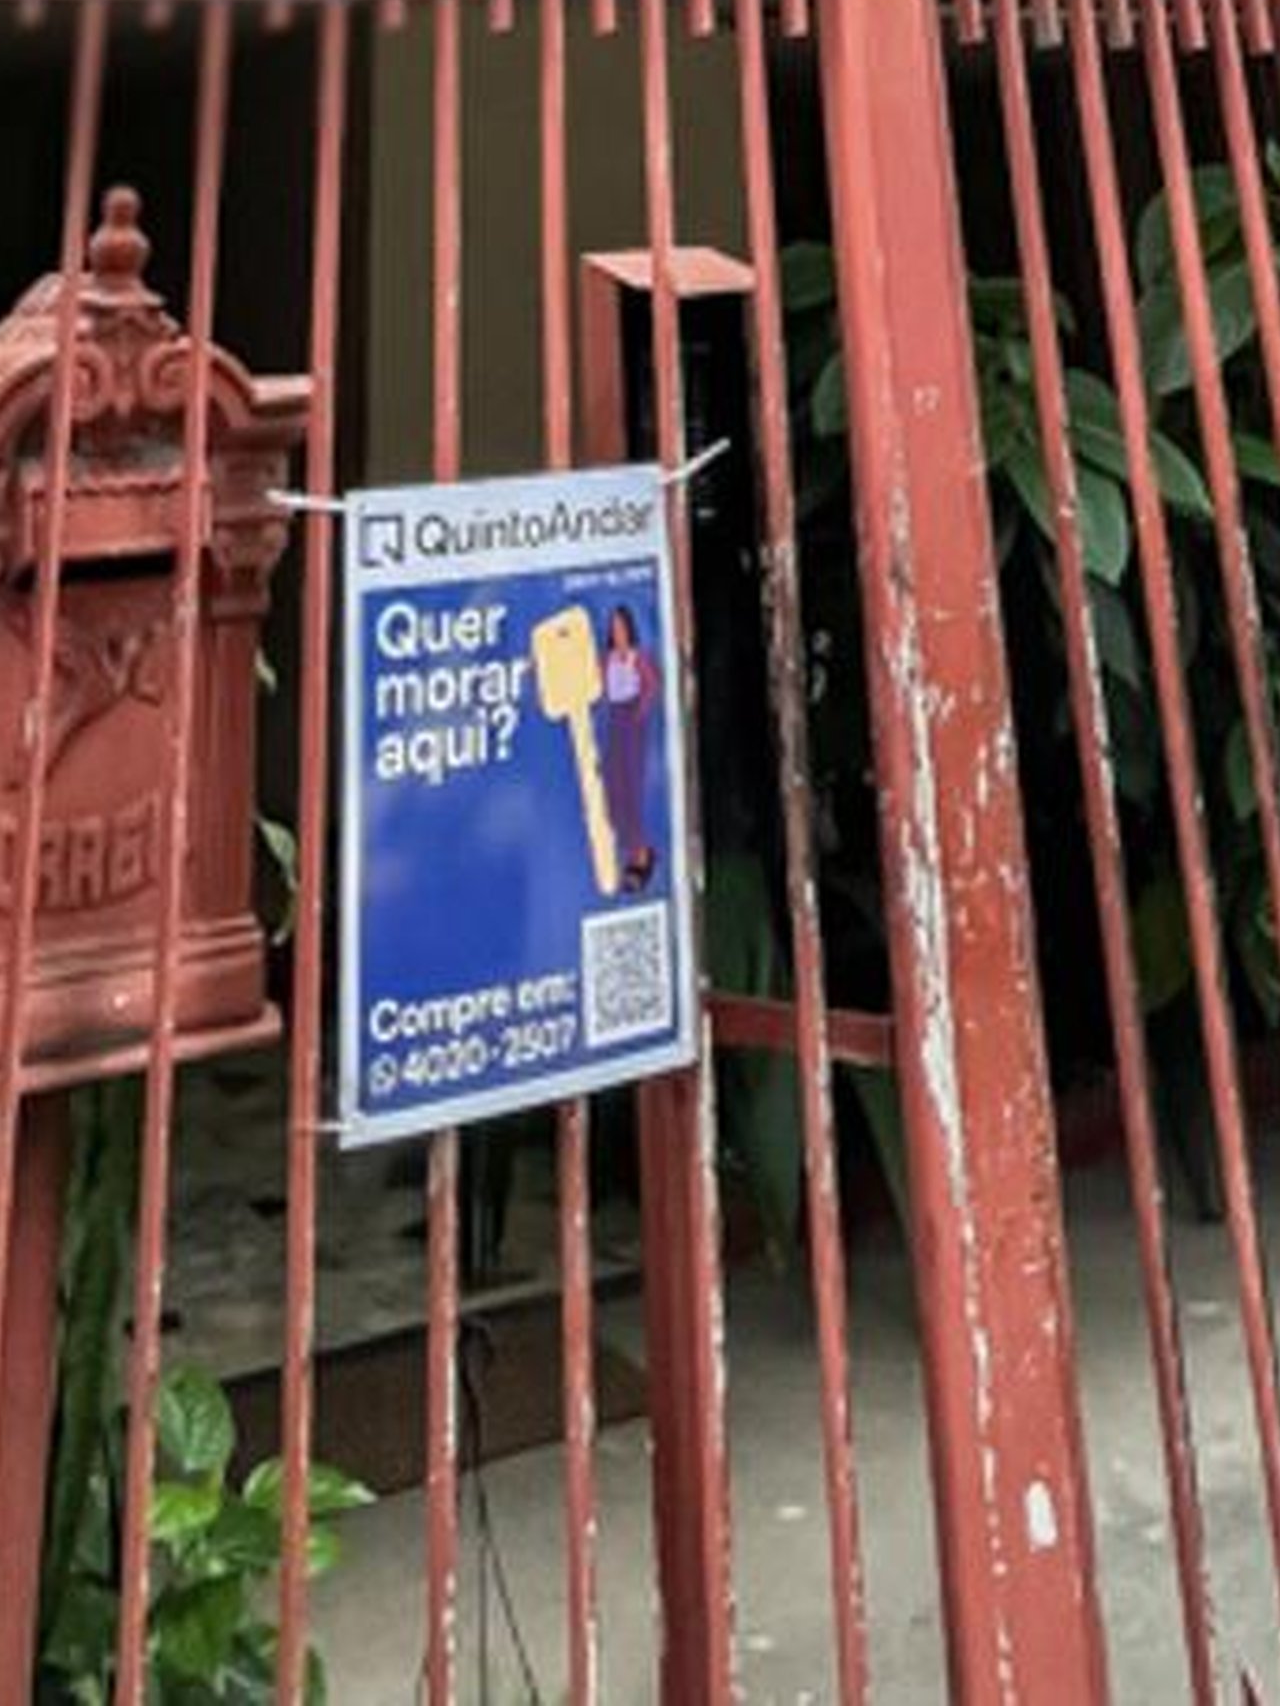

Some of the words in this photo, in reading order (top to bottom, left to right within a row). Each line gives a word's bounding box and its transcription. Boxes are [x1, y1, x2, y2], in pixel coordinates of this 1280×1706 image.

[415, 498, 652, 556] QuintoAndar
[376, 601, 507, 659] Quer
[376, 659, 529, 719] morar
[376, 704, 518, 786] aqui?
[370, 985, 511, 1042] Compre
[519, 972, 577, 1012] em:
